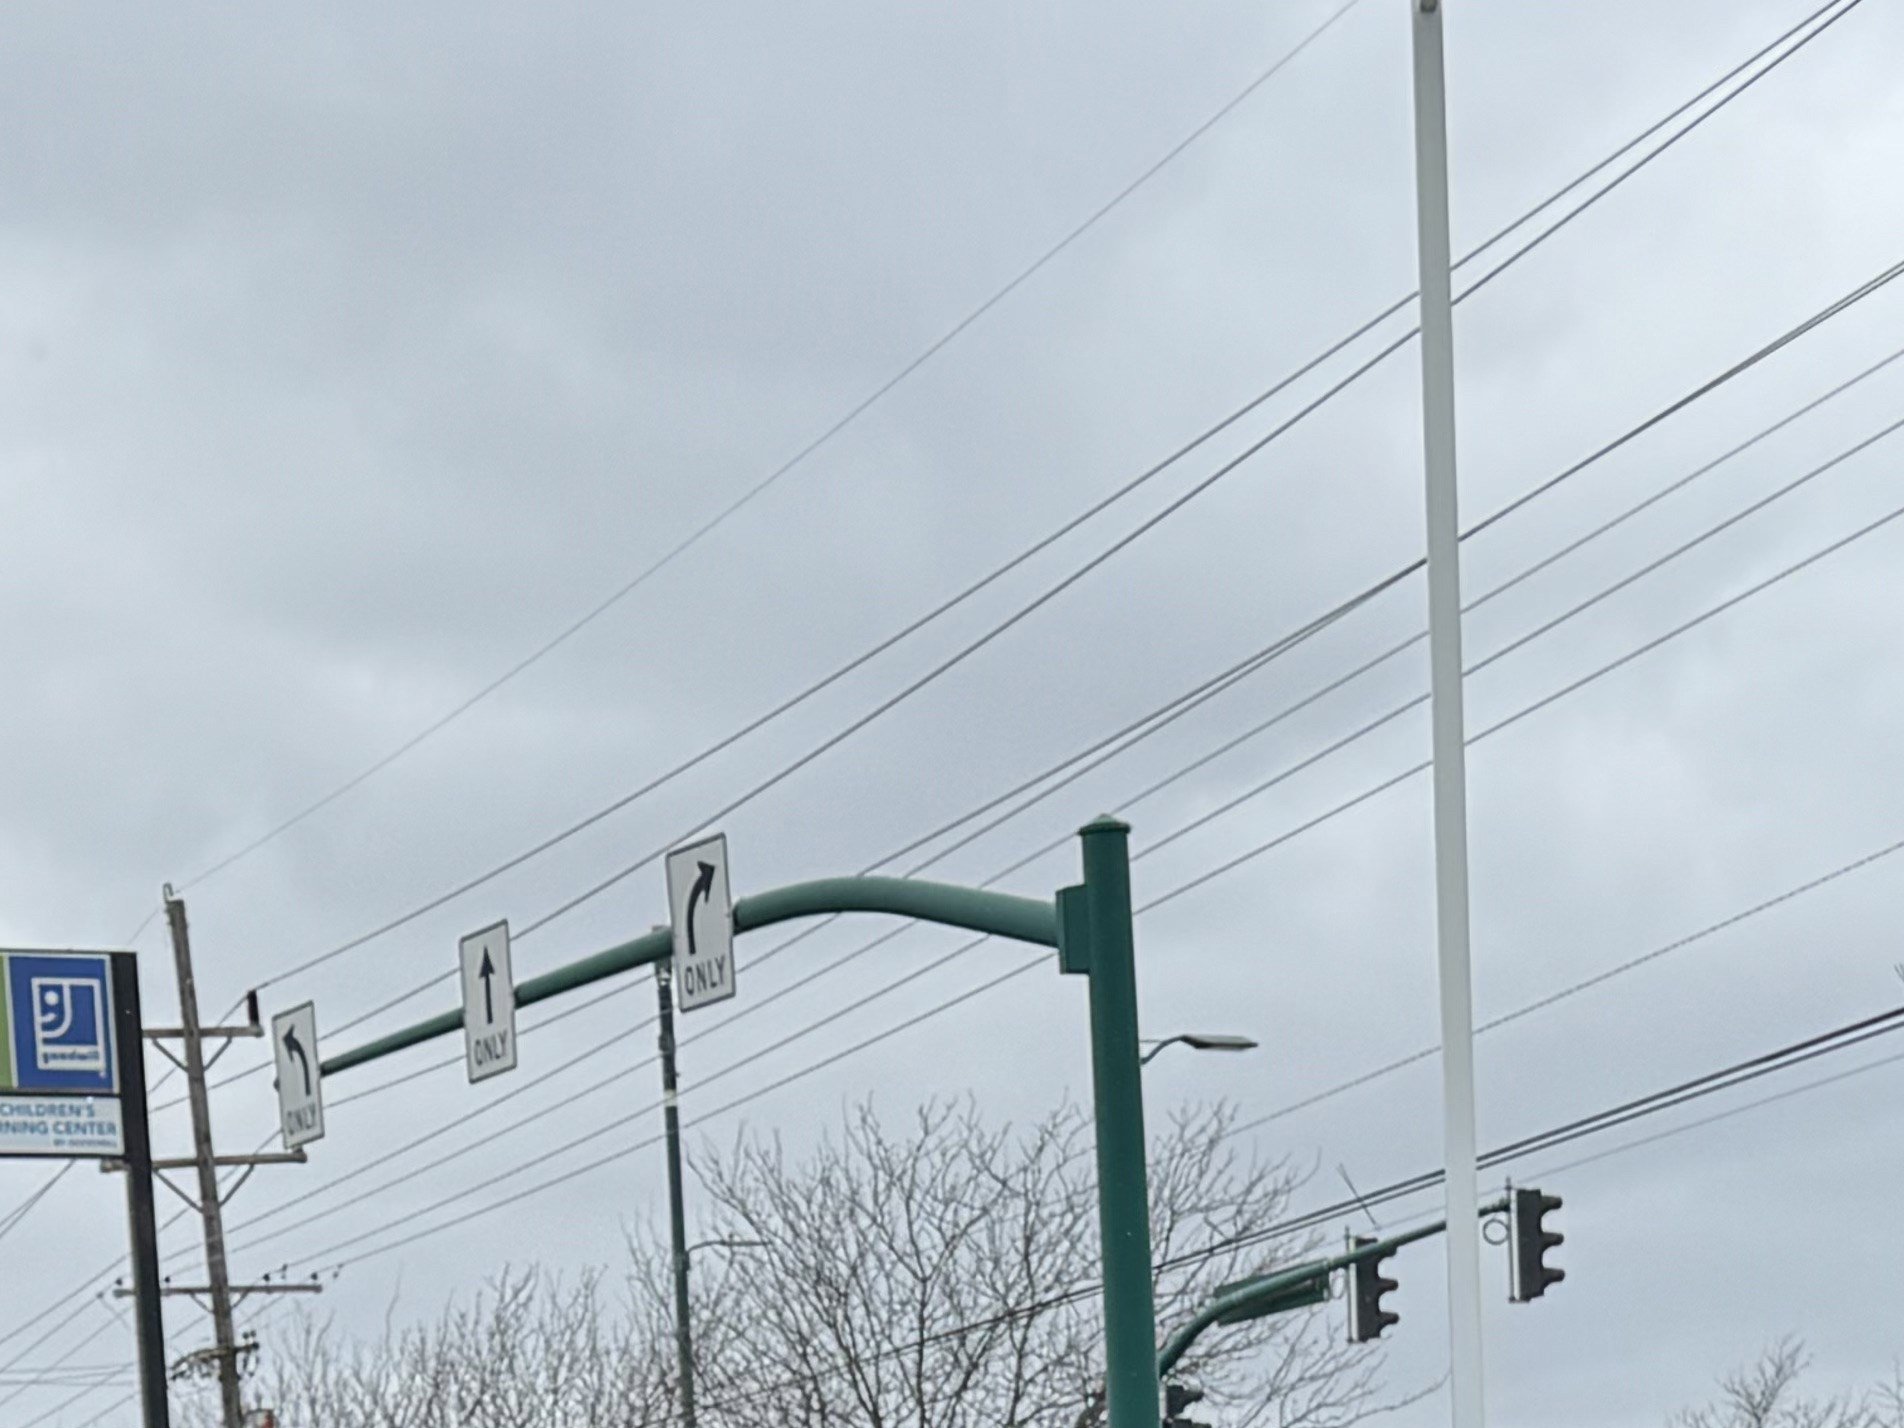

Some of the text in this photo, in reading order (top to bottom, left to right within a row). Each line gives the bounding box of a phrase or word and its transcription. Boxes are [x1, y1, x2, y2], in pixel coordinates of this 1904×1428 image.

[684, 954, 726, 996] ONLY
[473, 1030, 508, 1066] ONLY
[52, 1121, 118, 1136] CENTER
[286, 1103, 316, 1136] ONLY
